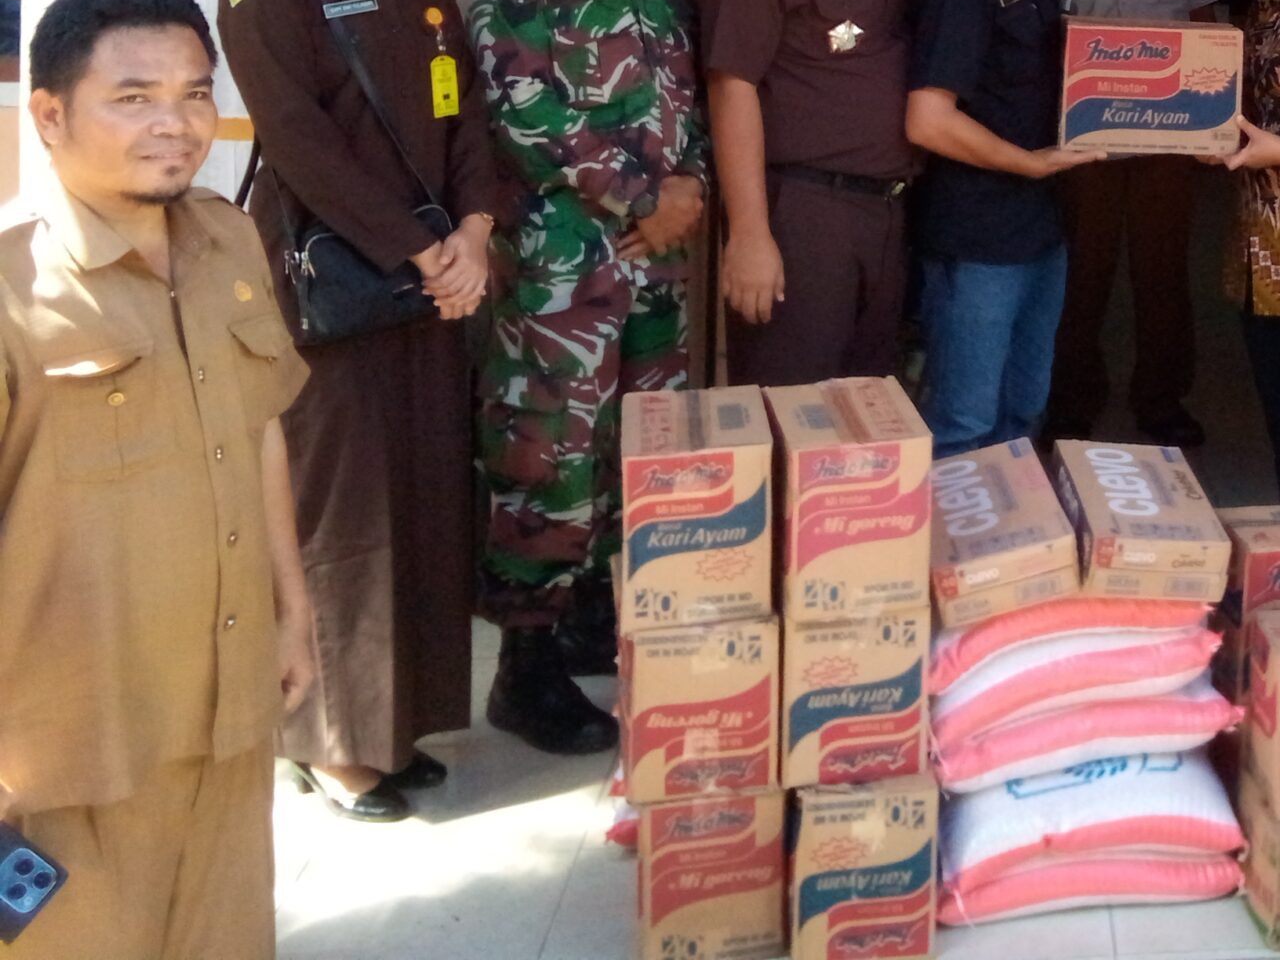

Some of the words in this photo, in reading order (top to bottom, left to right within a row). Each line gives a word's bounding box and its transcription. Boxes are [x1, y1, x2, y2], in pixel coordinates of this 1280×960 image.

[1102, 106, 1140, 124] Kari
[1141, 109, 1190, 128] Ayam
[647, 526, 692, 549] Kari
[692, 524, 748, 549] Ayam
